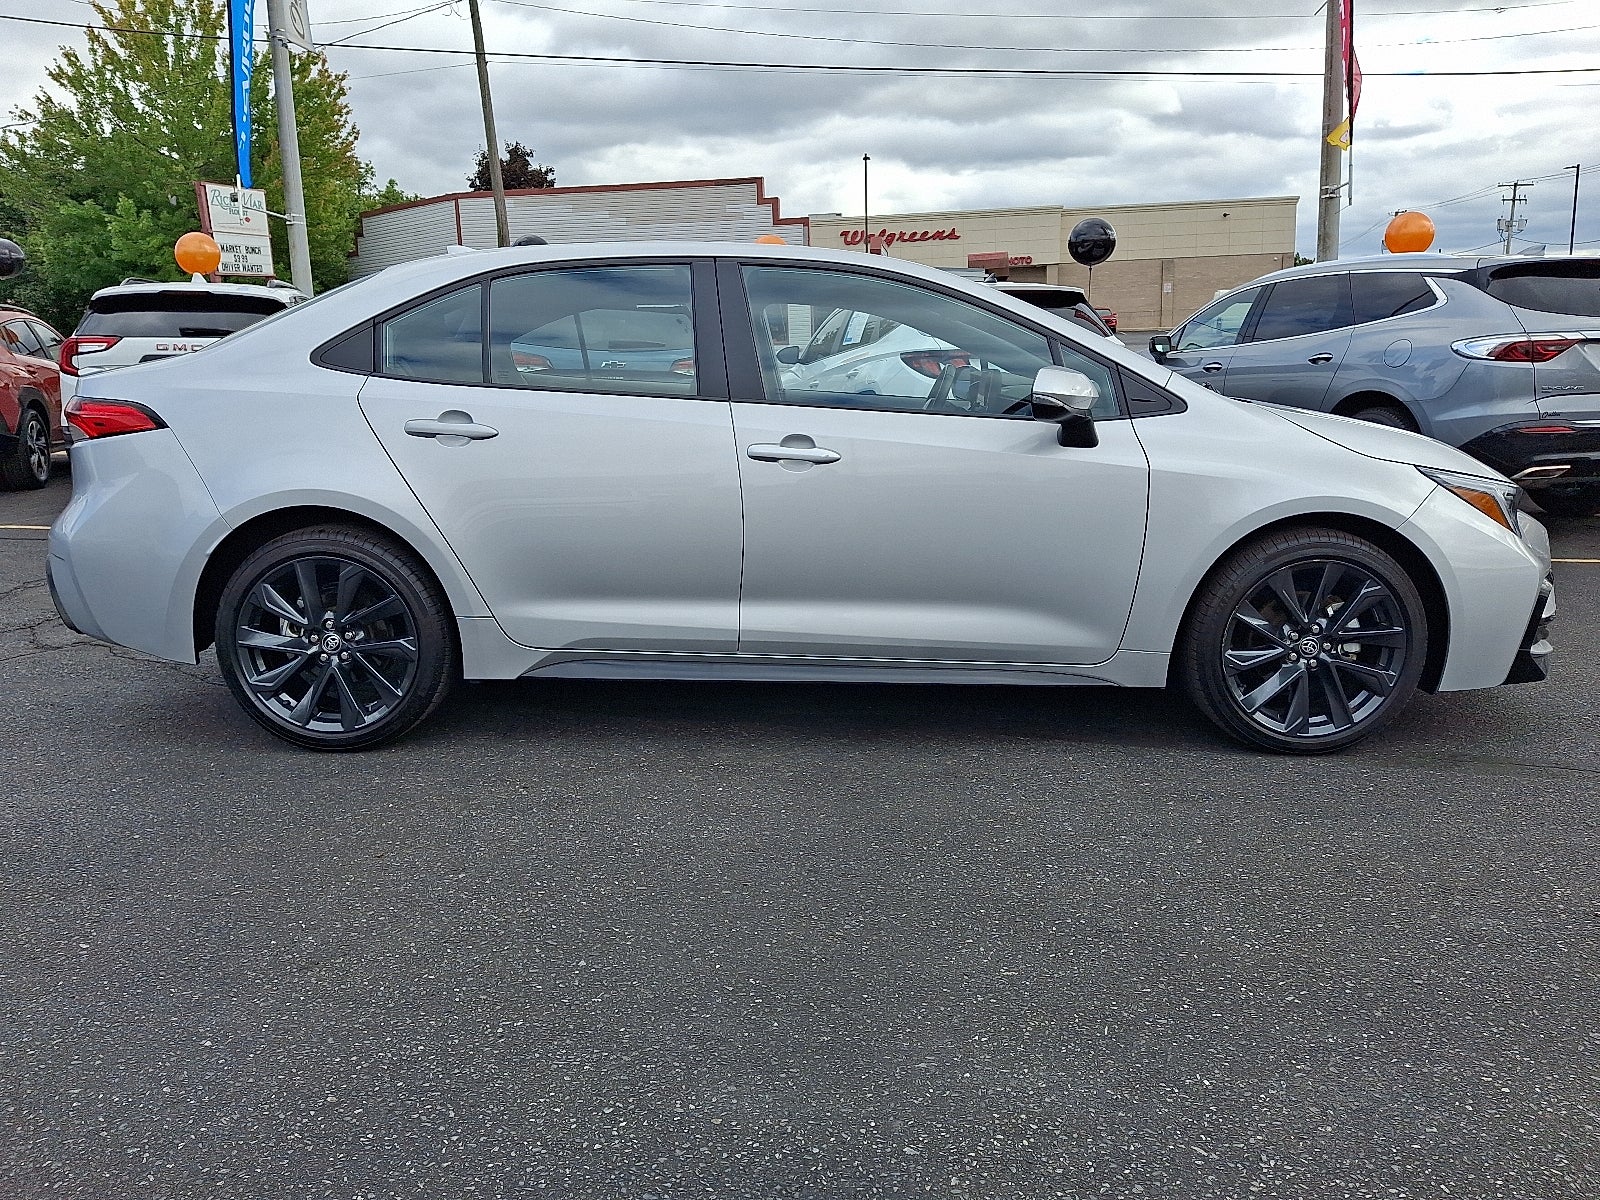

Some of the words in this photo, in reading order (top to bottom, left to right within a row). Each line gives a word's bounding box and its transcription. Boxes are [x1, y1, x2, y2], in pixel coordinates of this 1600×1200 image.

[228, 207, 249, 217] FLOST
[220, 244, 242, 254] MARKET
[244, 245, 262, 255] BUNCH
[221, 262, 241, 272] DRIVER
[241, 263, 263, 273] WANTED
[156, 343, 204, 352] GMC
